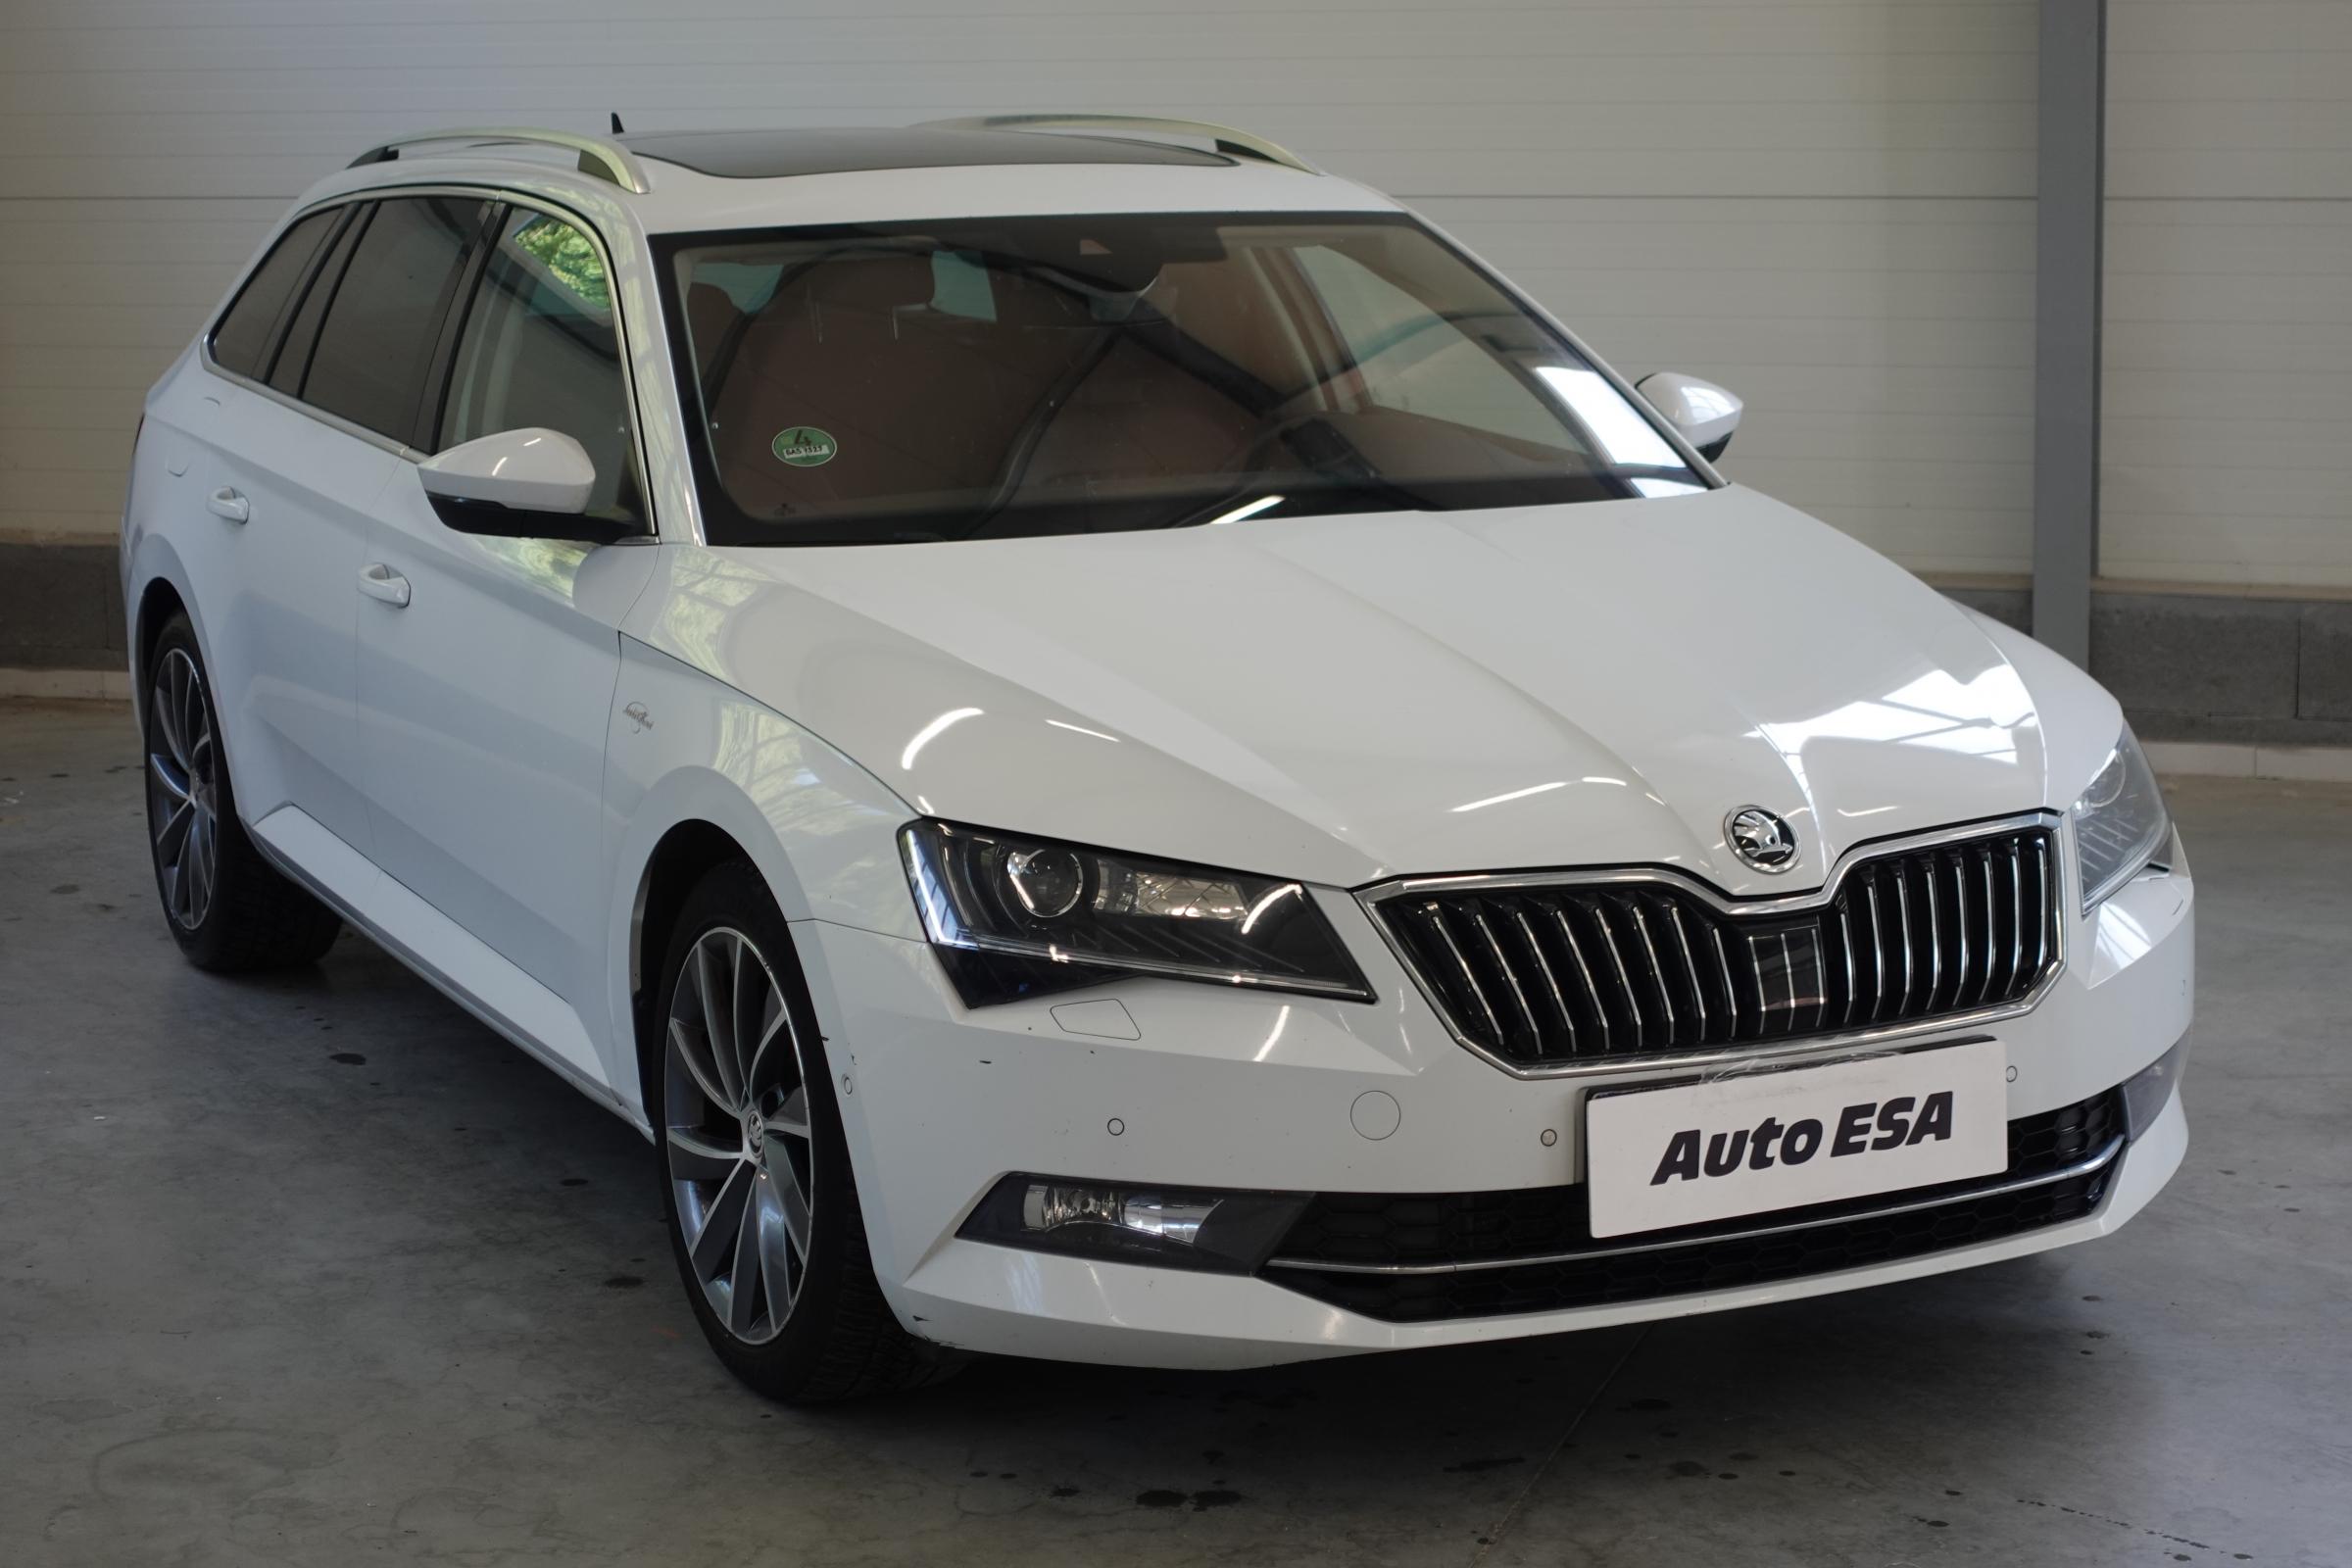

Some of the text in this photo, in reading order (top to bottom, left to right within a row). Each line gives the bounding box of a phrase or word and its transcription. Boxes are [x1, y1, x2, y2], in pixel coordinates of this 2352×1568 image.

[795, 429, 811, 446] 4
[1650, 1091, 1953, 1186] Auto ESA
